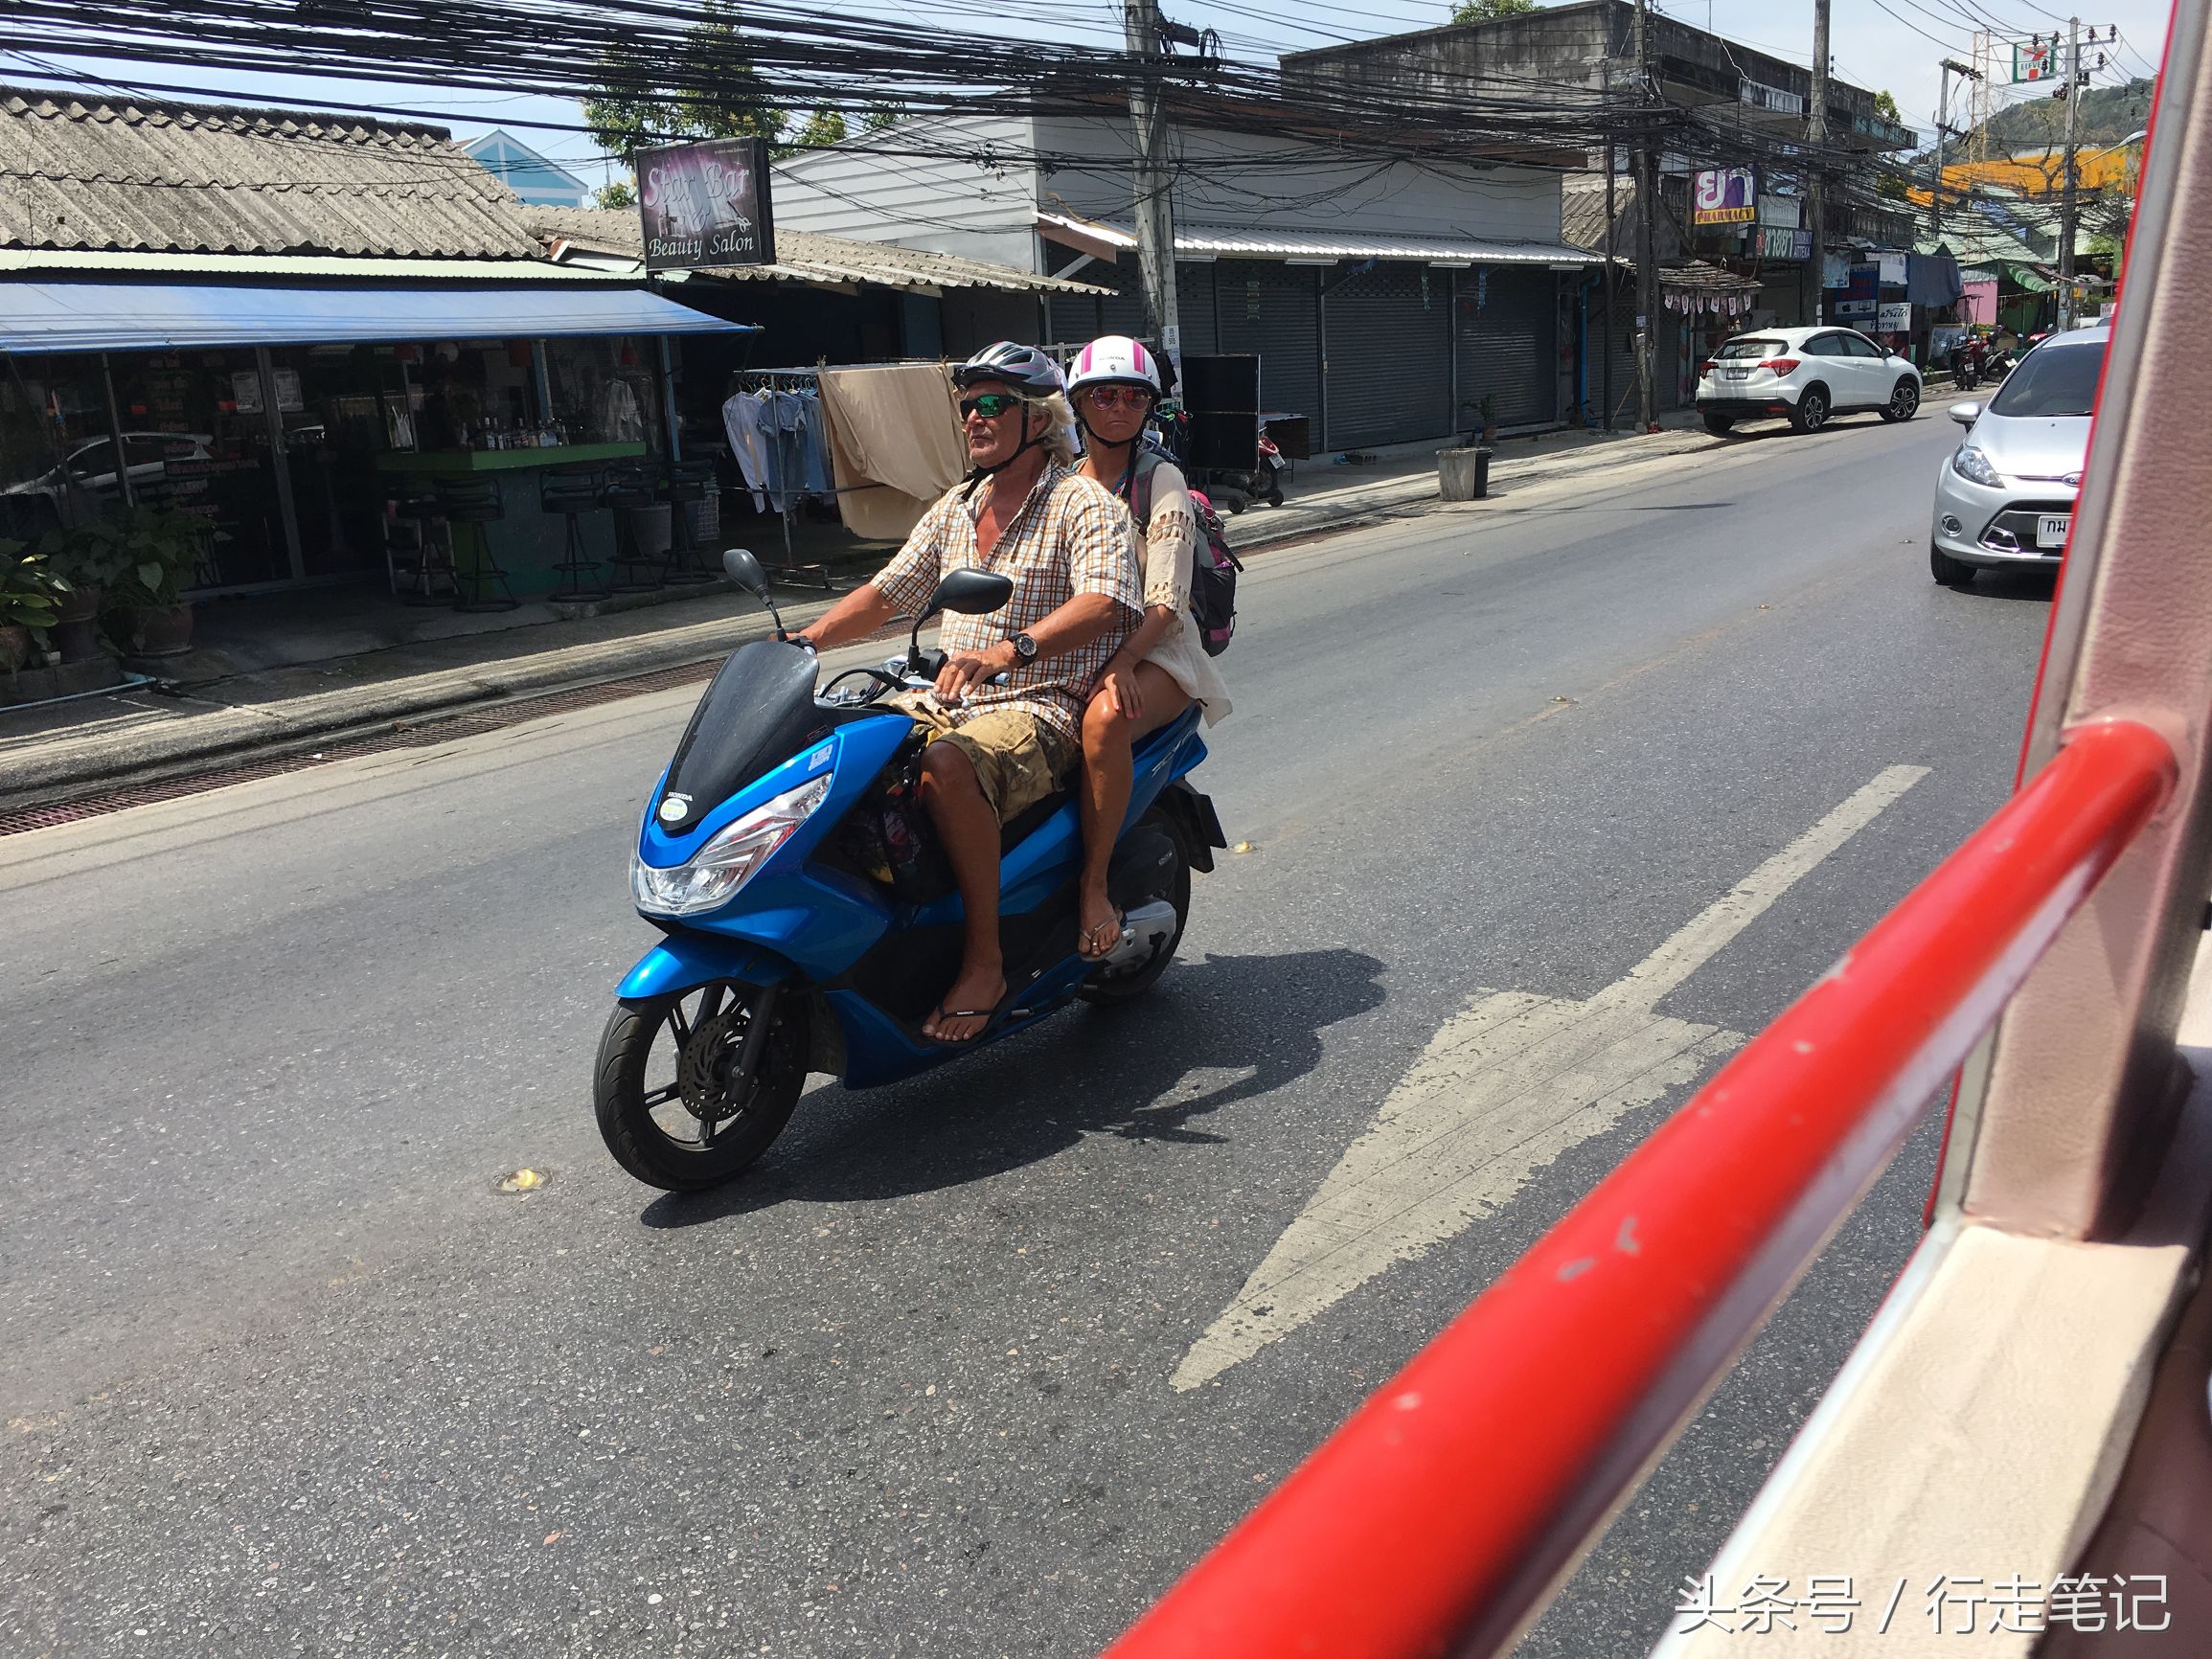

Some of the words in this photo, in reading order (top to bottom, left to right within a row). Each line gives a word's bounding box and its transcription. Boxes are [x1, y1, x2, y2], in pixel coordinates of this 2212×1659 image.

[2020, 60, 2045, 71] ELEVE
[2022, 45, 2048, 80] 7
[644, 161, 696, 207] Star
[705, 162, 750, 201] Bar
[1697, 168, 1753, 210] ยา
[1697, 208, 1752, 222] PHARMACY
[649, 238, 702, 261] Beauty
[709, 230, 754, 255] Salon
[1765, 228, 1793, 258] ขายยา
[667, 791, 694, 801] HONDA
